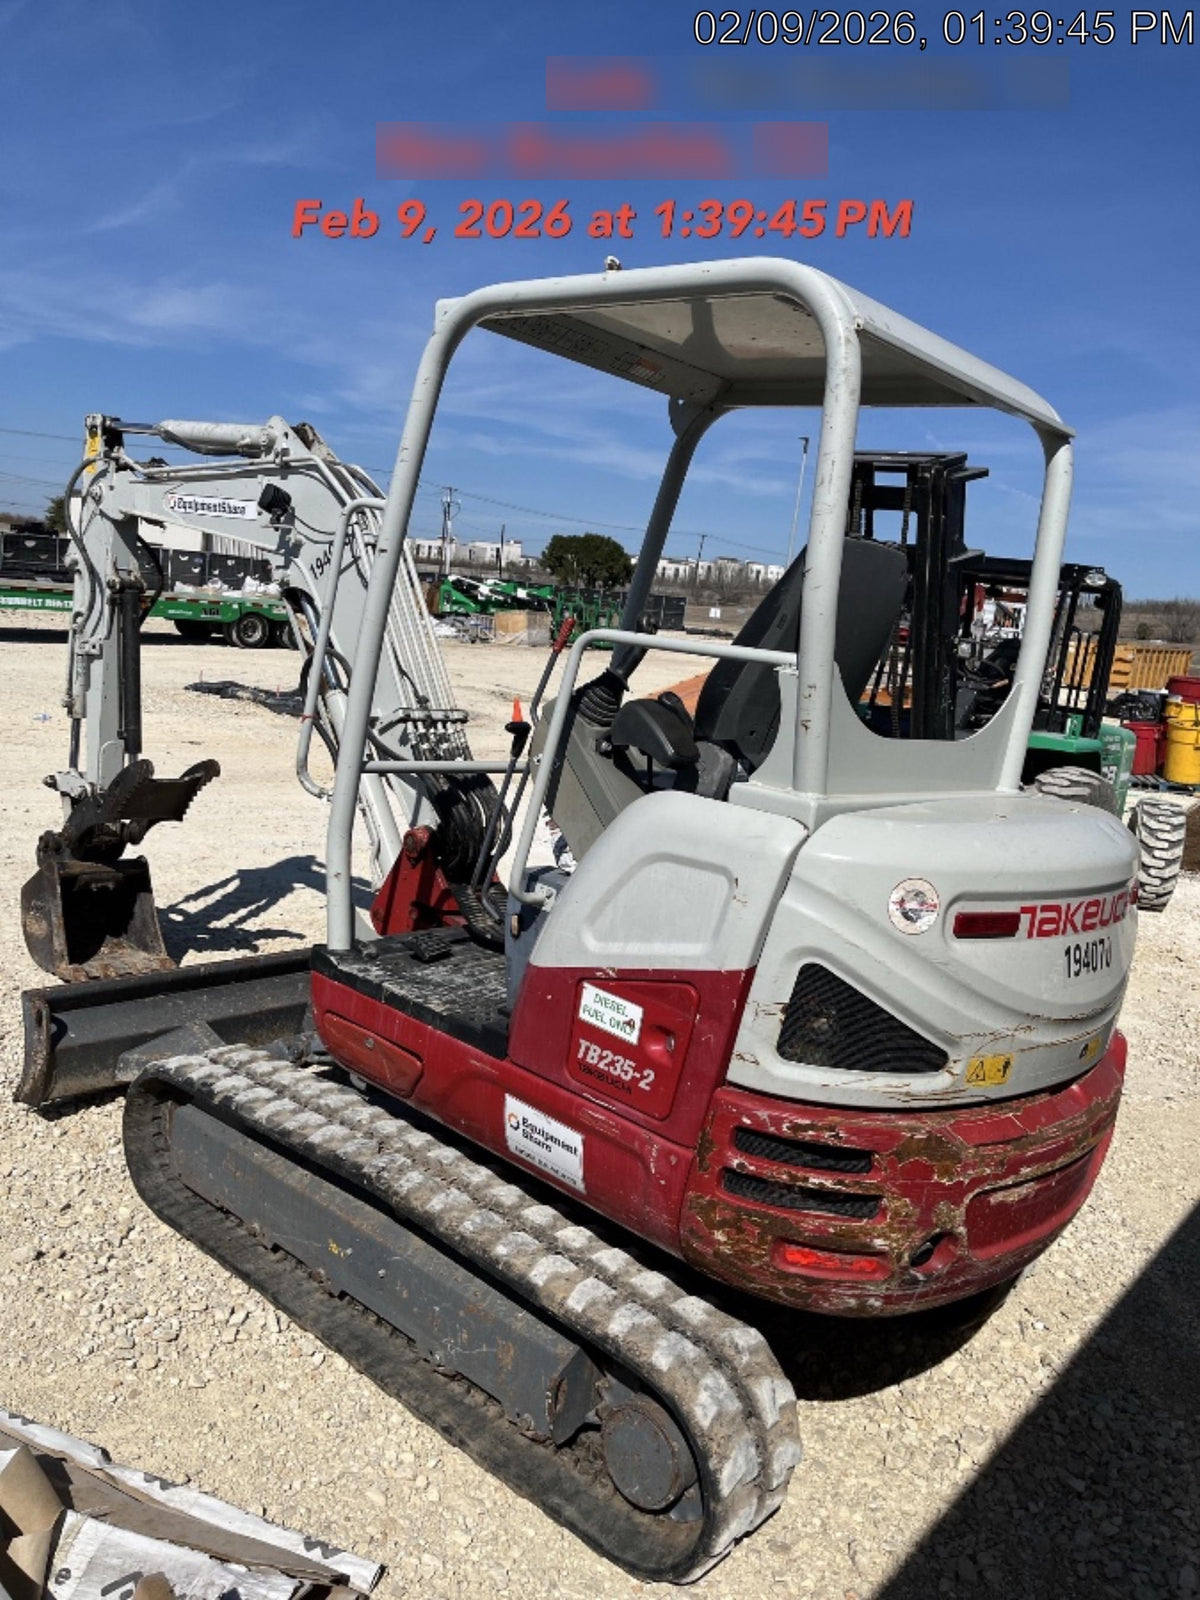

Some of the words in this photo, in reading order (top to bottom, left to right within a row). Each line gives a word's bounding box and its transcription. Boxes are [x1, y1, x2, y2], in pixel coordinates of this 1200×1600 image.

[582, 1003, 606, 1024] FUEL
[593, 993, 628, 1017] DIESEL
[577, 1038, 656, 1092] TB235-2
[521, 1116, 579, 1157] Equipment
[521, 1128, 552, 1153] Share
